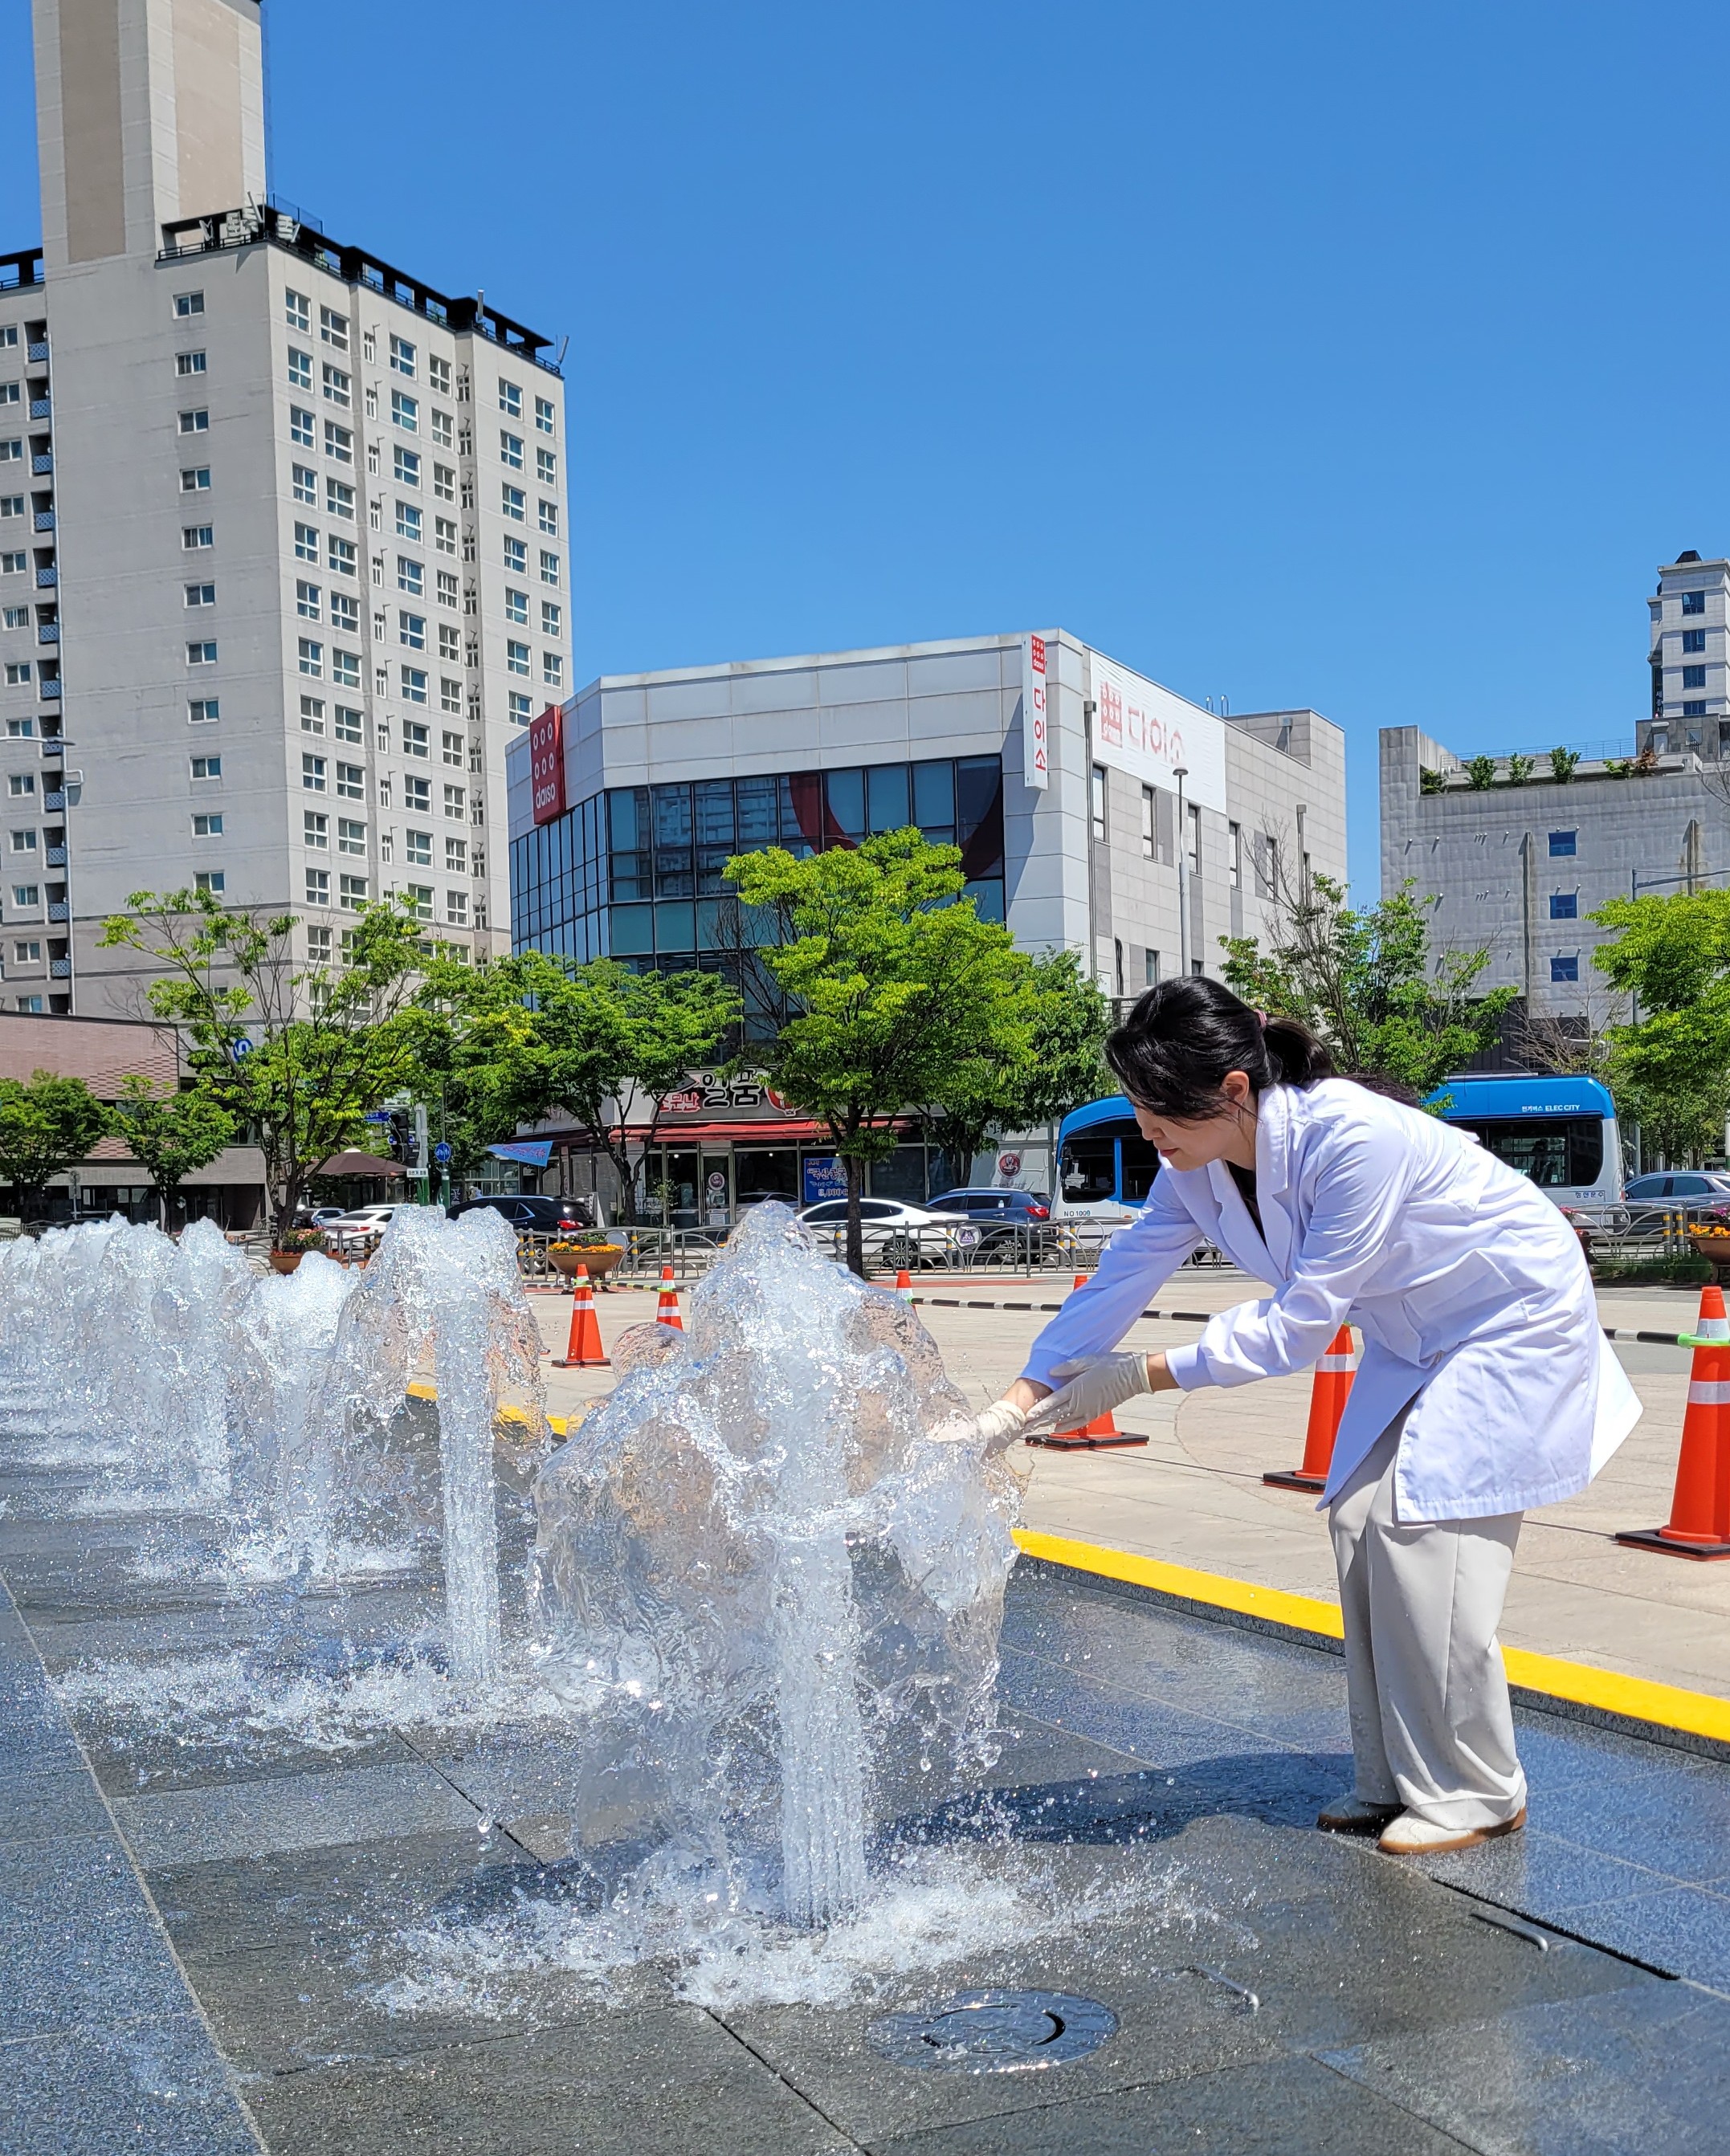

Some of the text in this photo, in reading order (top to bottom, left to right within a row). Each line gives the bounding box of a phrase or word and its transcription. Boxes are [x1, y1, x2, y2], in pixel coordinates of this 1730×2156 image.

[1033, 687, 1047, 772] 다이소
[1128, 706, 1187, 768] 다이소
[535, 781, 556, 809] daiso
